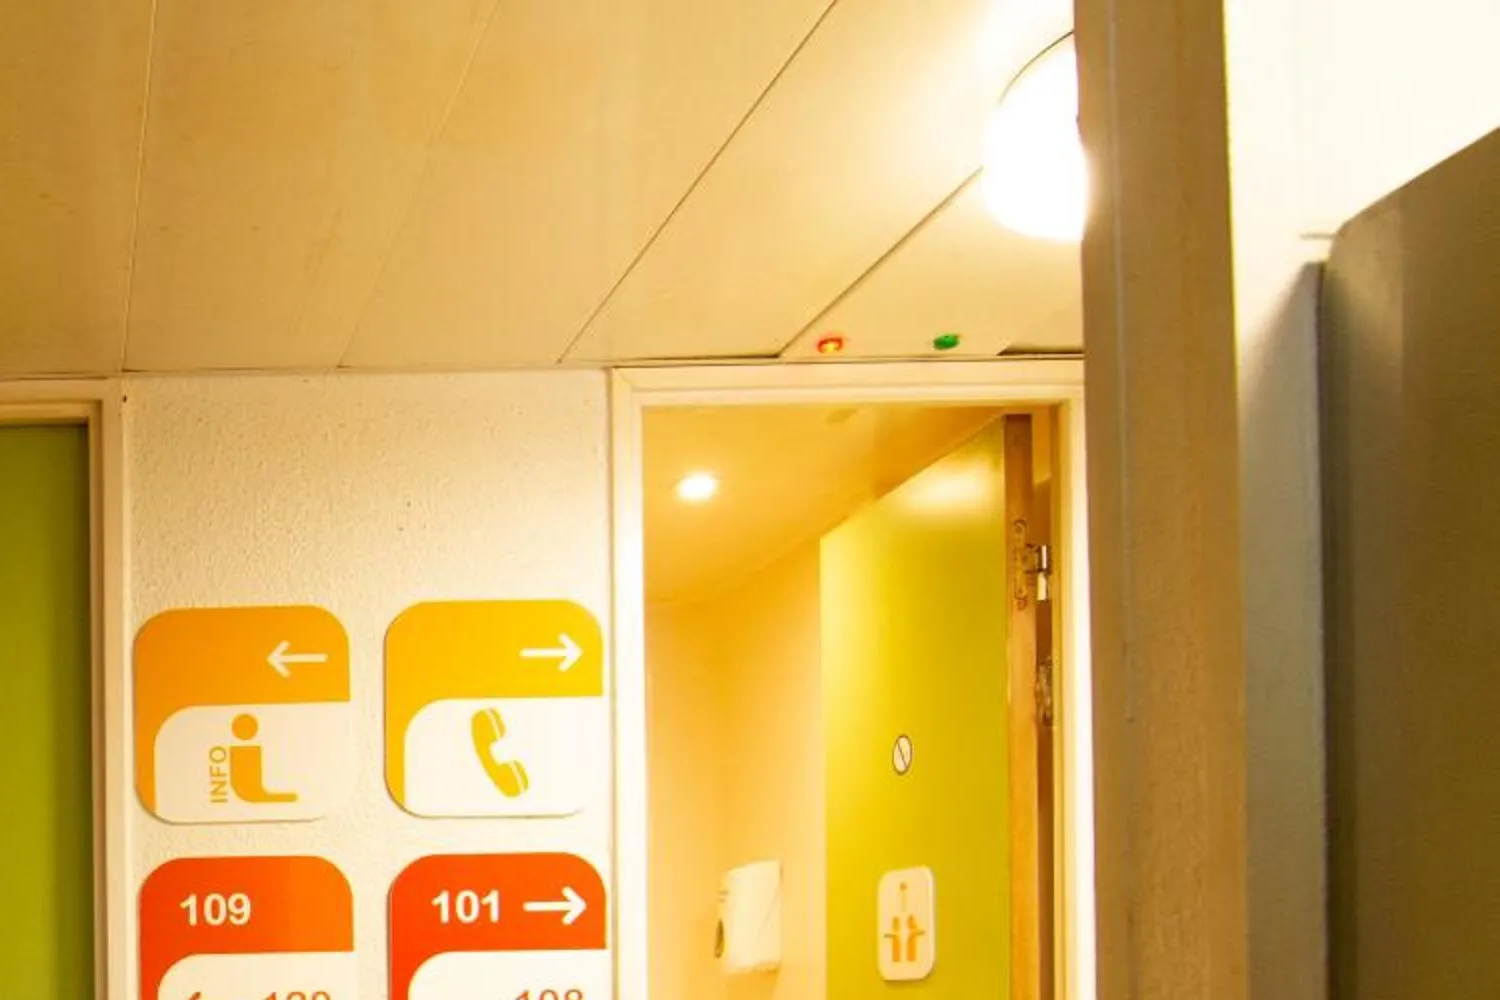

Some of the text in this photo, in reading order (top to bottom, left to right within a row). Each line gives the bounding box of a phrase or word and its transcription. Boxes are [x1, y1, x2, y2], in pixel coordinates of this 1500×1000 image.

[209, 745, 228, 804] INFO
[179, 893, 252, 926] 109
[431, 889, 500, 924] 101
